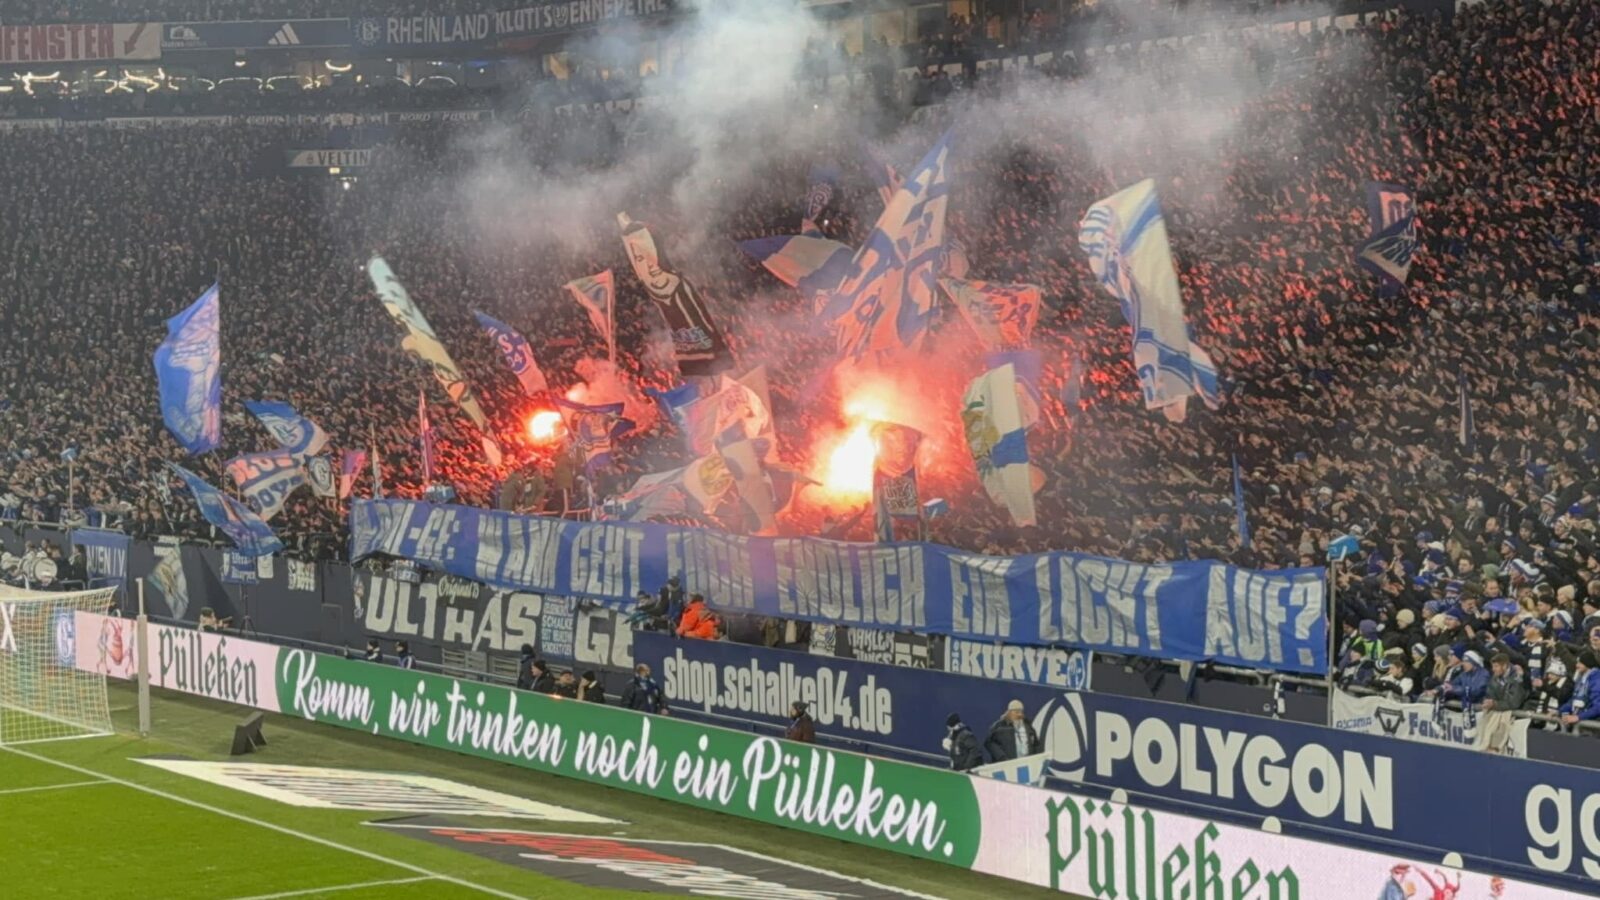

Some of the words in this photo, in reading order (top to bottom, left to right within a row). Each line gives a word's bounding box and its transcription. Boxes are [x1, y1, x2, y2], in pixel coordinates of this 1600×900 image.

[0, 24, 114, 62] FENSTER
[386, 13, 490, 44] RHEINLAND
[1034, 556, 1174, 650] LICHT
[1204, 564, 1322, 667] AUF?
[159, 626, 259, 706] Pülleken
[663, 647, 893, 735] shop.schalke04.de
[960, 640, 1067, 686] KURVE
[283, 649, 380, 735] Komm,
[388, 679, 441, 738] wir
[446, 679, 568, 767] trinken
[574, 716, 668, 790] noch
[673, 734, 739, 806] ein
[742, 736, 955, 858] Pülleken.
[1095, 710, 1393, 831] POLYGON
